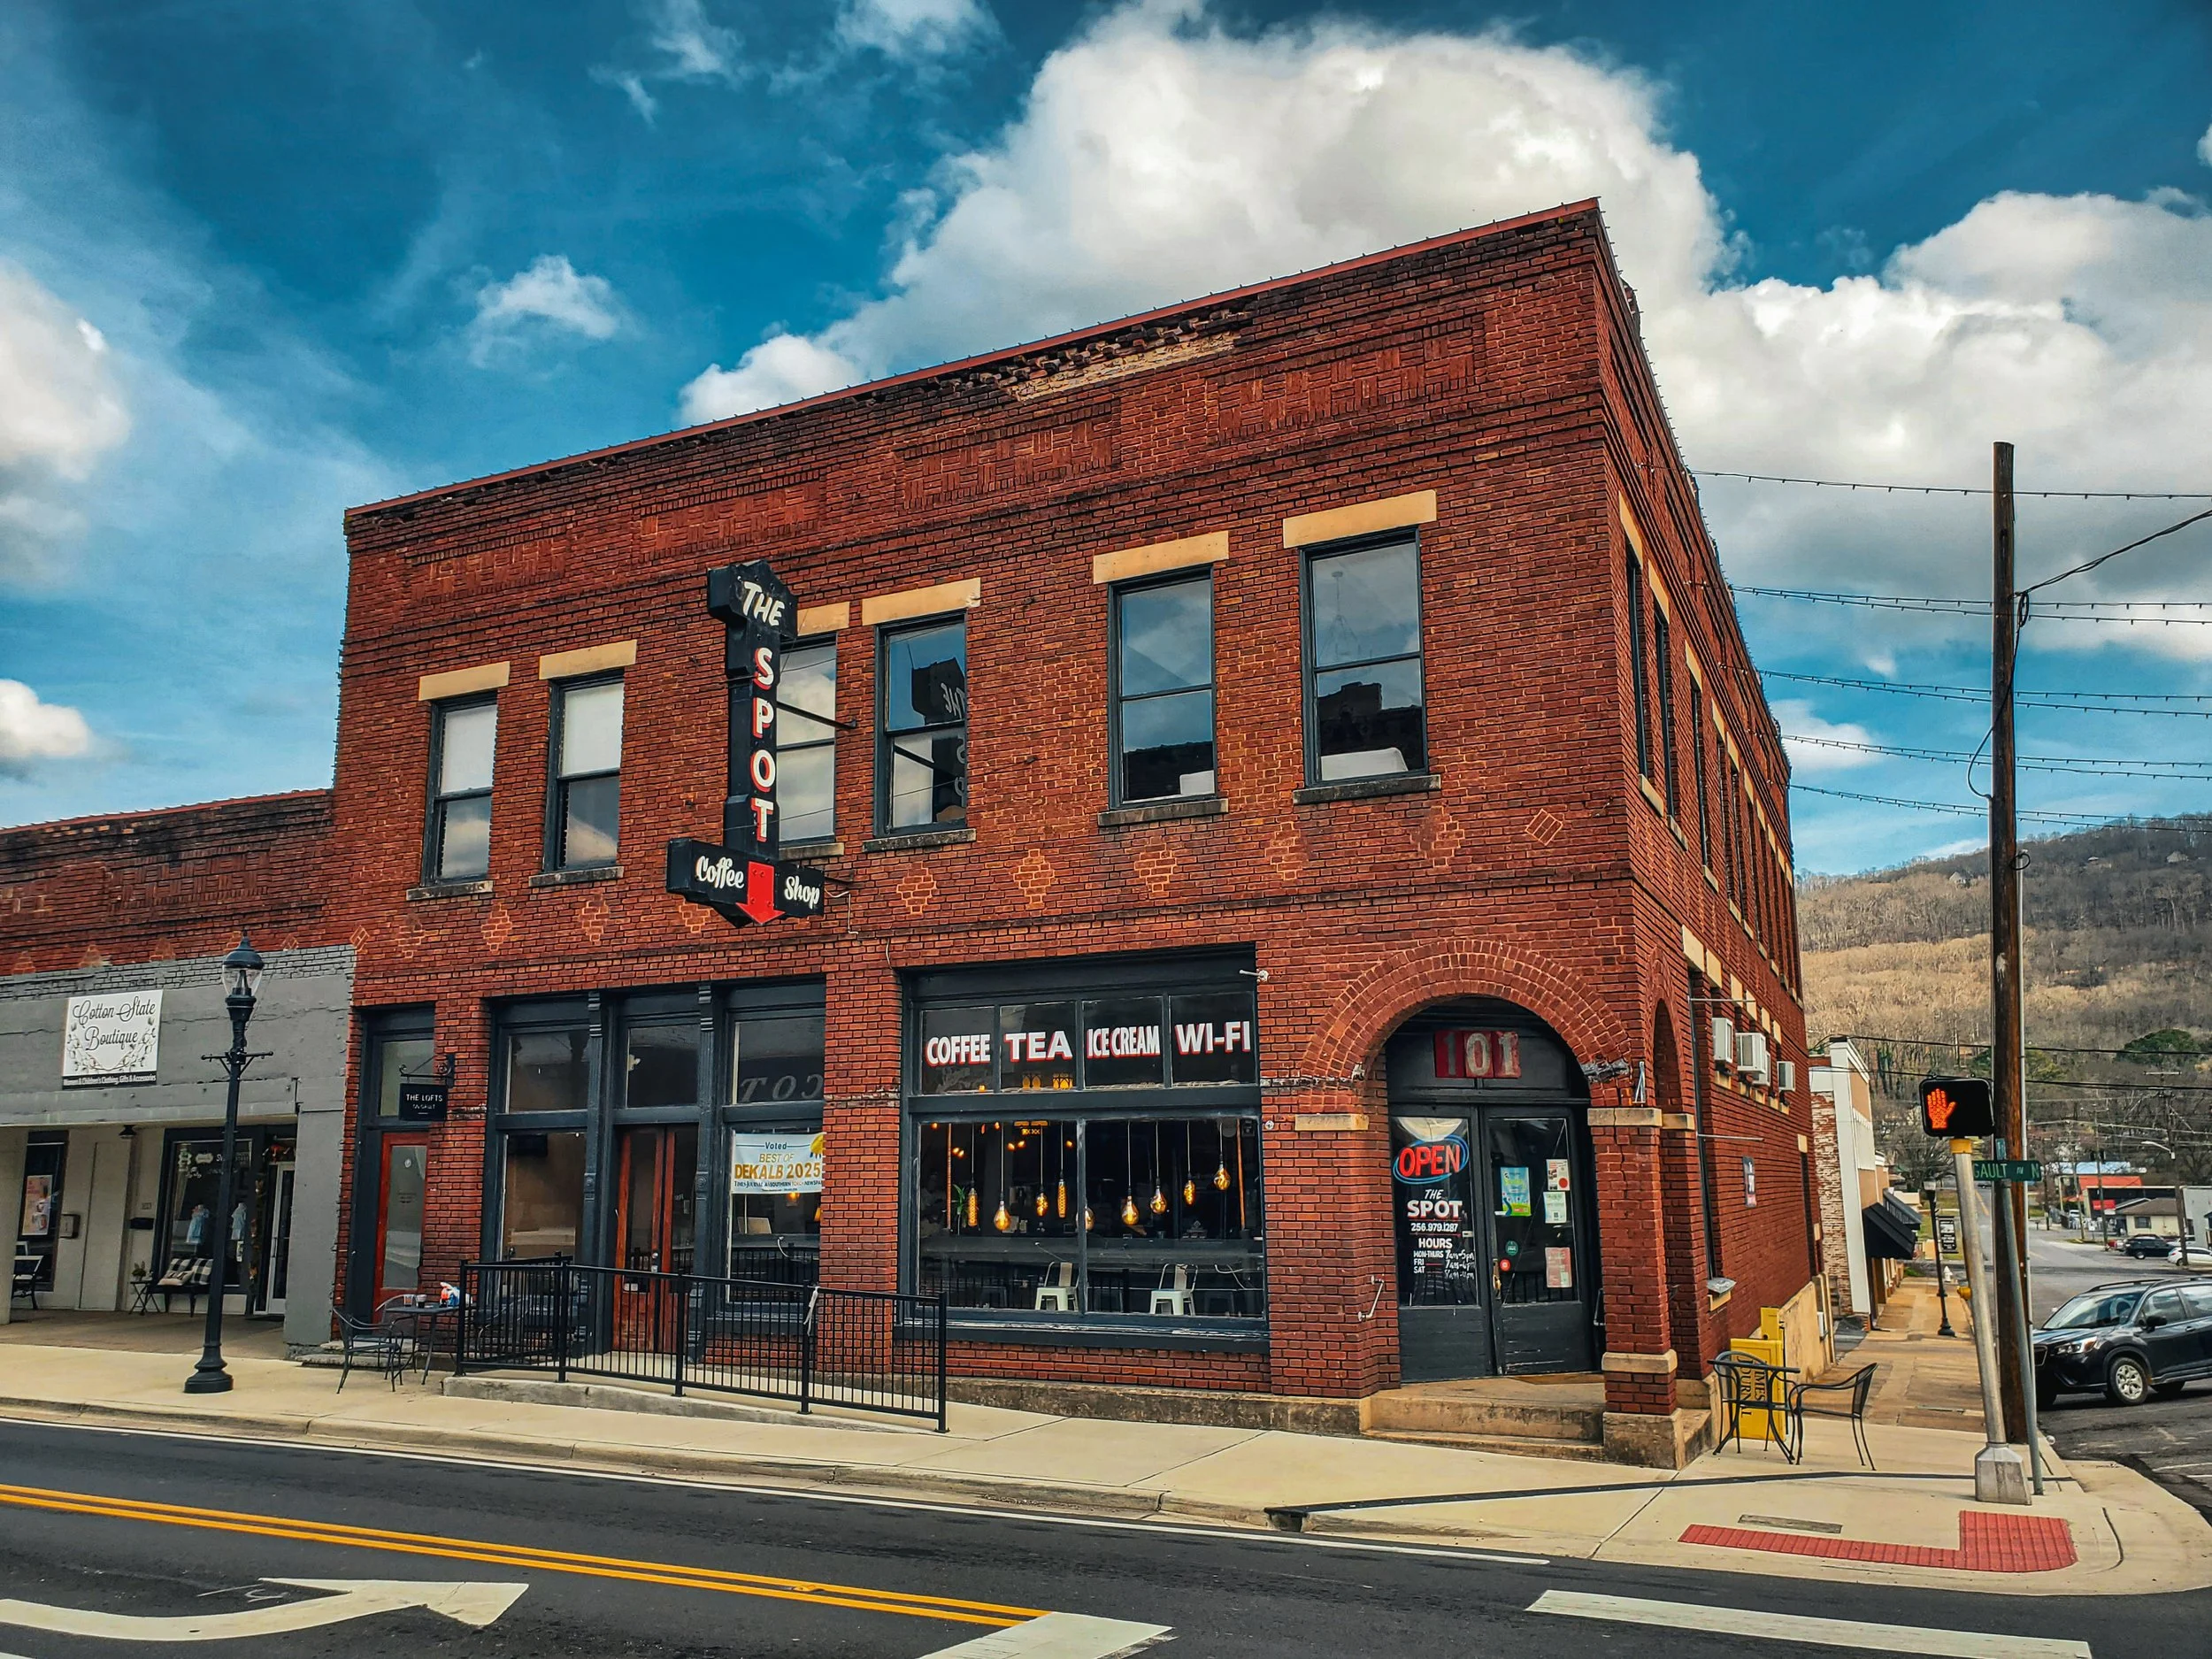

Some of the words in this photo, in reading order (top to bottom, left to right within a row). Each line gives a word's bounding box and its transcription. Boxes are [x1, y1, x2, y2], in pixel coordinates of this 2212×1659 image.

[743, 581, 785, 626] THE
[750, 647, 776, 842] SPOT
[695, 856, 745, 889] Coffee
[784, 875, 820, 910] Shop
[73, 1000, 115, 1028] Cotton
[116, 996, 156, 1022] State
[85, 1026, 138, 1050] Boutique
[926, 1033, 991, 1067] COFFEE
[1003, 1030, 1073, 1063] TEA
[1087, 1027, 1110, 1059] ICE
[1110, 1025, 1161, 1058] CREAM
[1174, 1020, 1251, 1056] WI-FI
[1445, 1032, 1517, 1076] 101
[759, 1153, 780, 1163] BEST
[783, 1153, 795, 1163] OF
[764, 1141, 787, 1150] Voted
[1399, 1145, 1460, 1177] OPEN
[734, 1164, 784, 1179] DEKALB
[787, 1163, 821, 1179] 2025
[2031, 1164, 2040, 1179] N
[1407, 1200, 1463, 1218] SPOT
[1425, 1189, 1444, 1200] THE
[1410, 1222, 1459, 1232] 256.979.1287
[1418, 1238, 1453, 1248] HOURS
[1737, 1356, 1753, 1418] JOURNL
[1754, 1361, 1767, 1402] IMES
